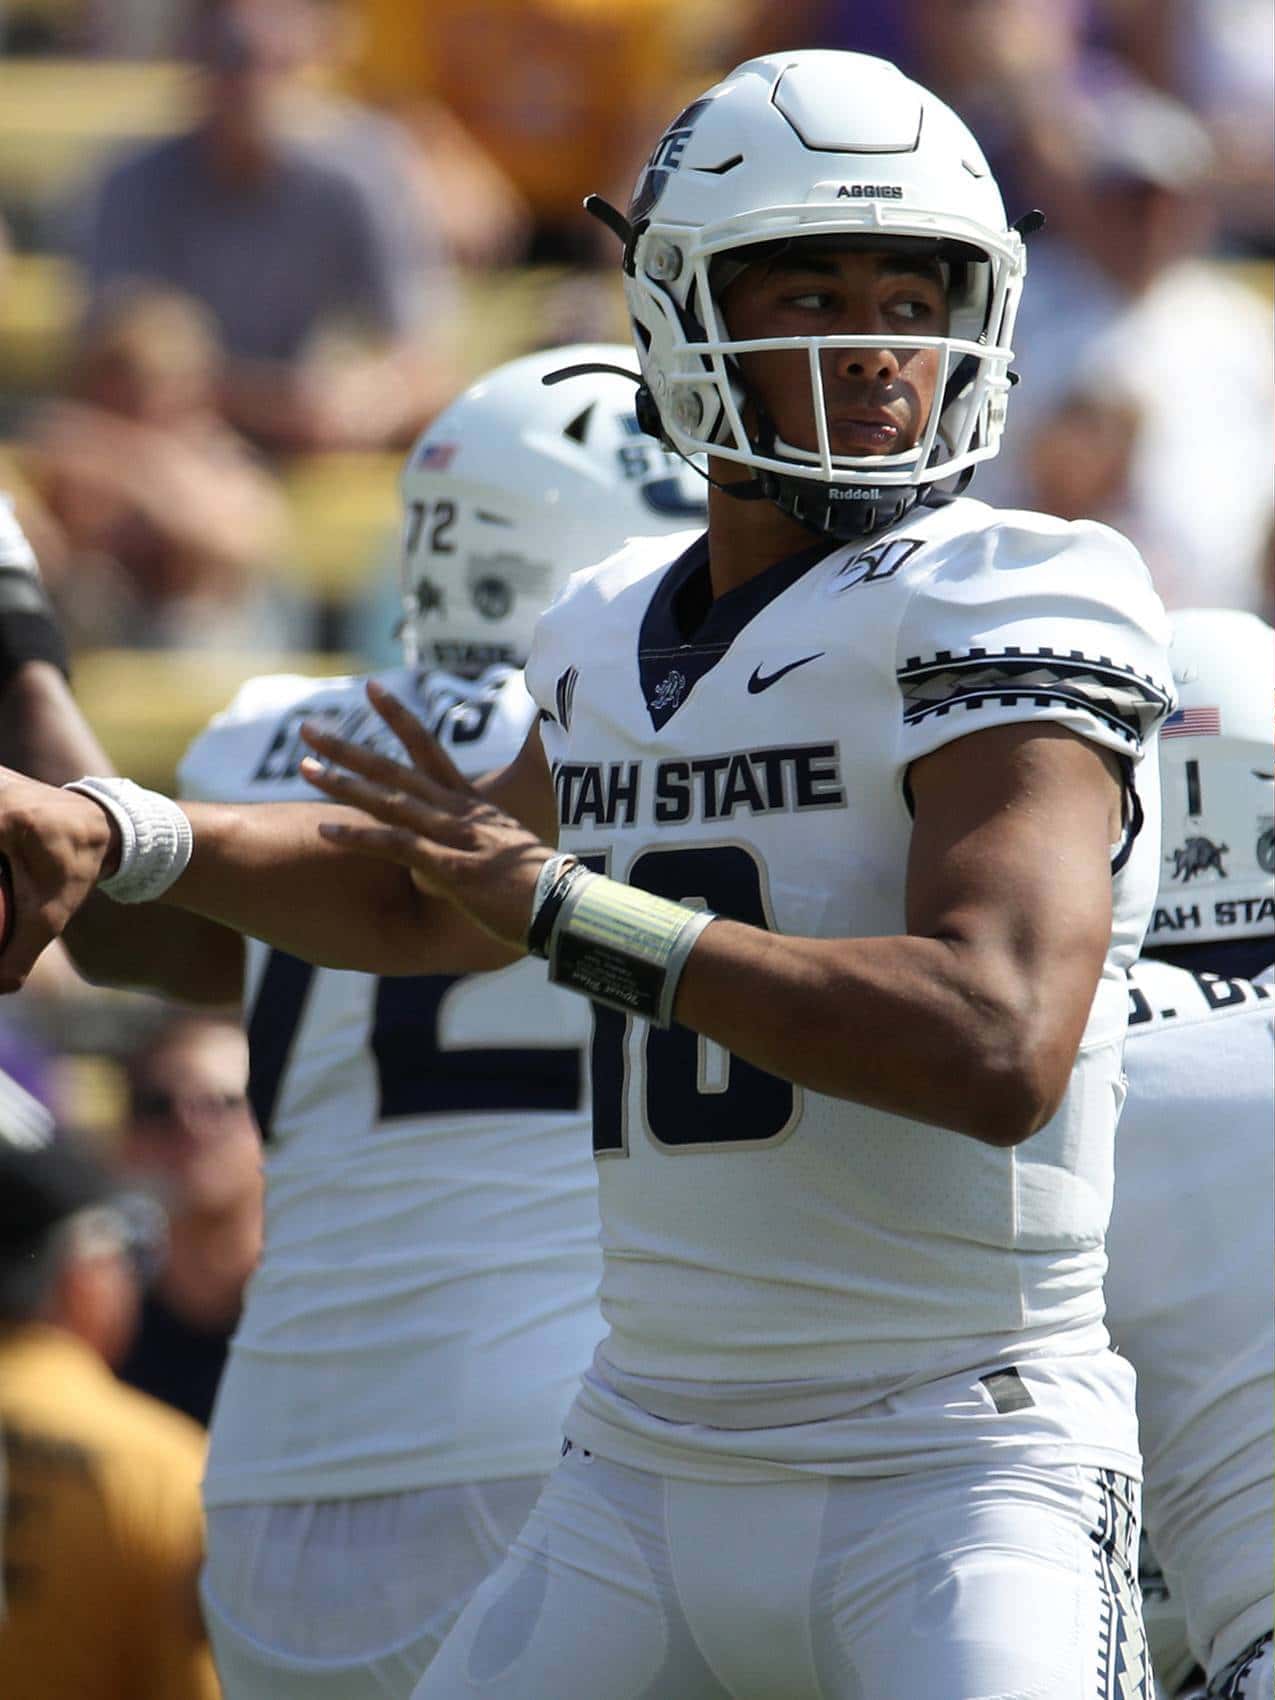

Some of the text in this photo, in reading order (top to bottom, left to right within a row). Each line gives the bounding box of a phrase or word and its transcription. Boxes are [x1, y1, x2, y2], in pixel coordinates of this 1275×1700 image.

[836, 185, 903, 199] AGGIES
[406, 499, 457, 554] 72
[654, 739, 850, 829] STATE
[1148, 904, 1200, 933] AH
